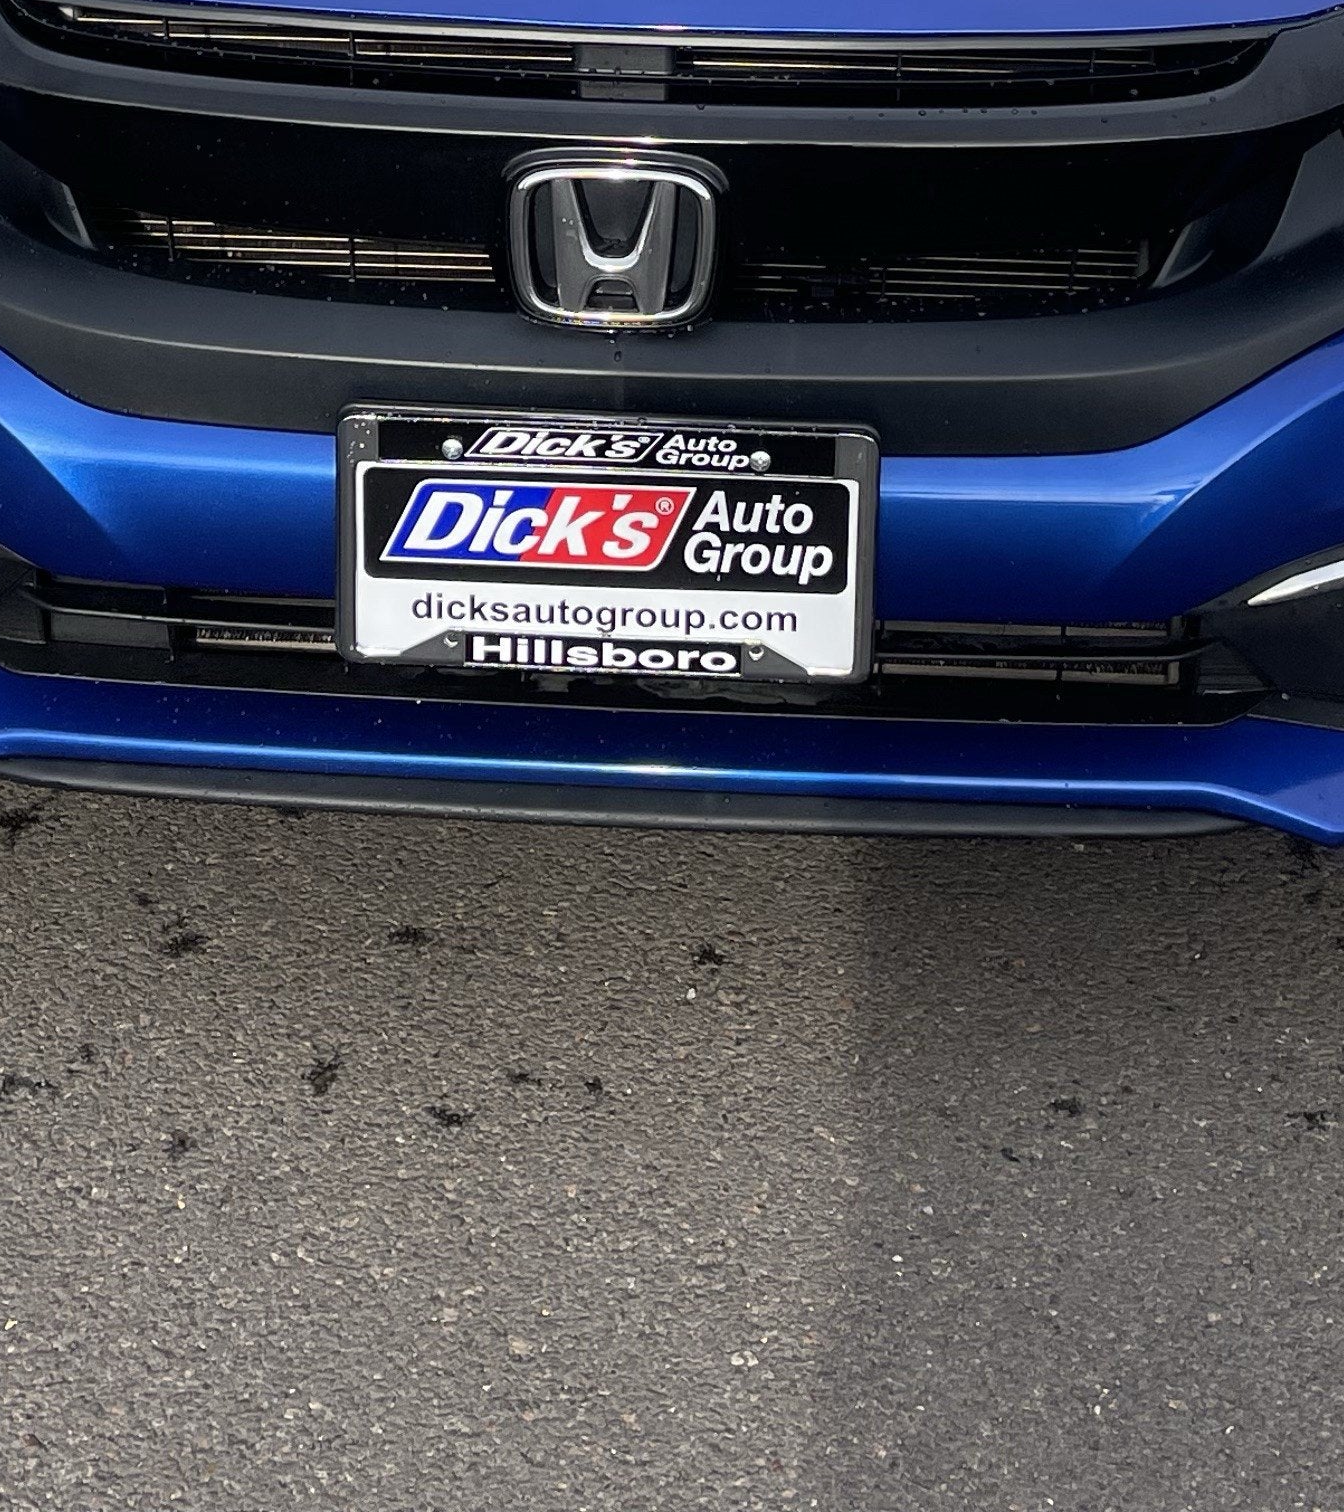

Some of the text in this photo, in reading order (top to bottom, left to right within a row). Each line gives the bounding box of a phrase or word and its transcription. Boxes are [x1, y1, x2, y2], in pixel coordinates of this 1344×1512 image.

[479, 430, 639, 460] Dick's
[655, 450, 749, 471] Group
[662, 435, 737, 452] Auto
[403, 490, 659, 558] Dick's
[694, 490, 814, 535] Auto
[683, 534, 833, 585] Group
[411, 593, 798, 633] dicksautogroup.com
[472, 636, 738, 672] Hillsboro
